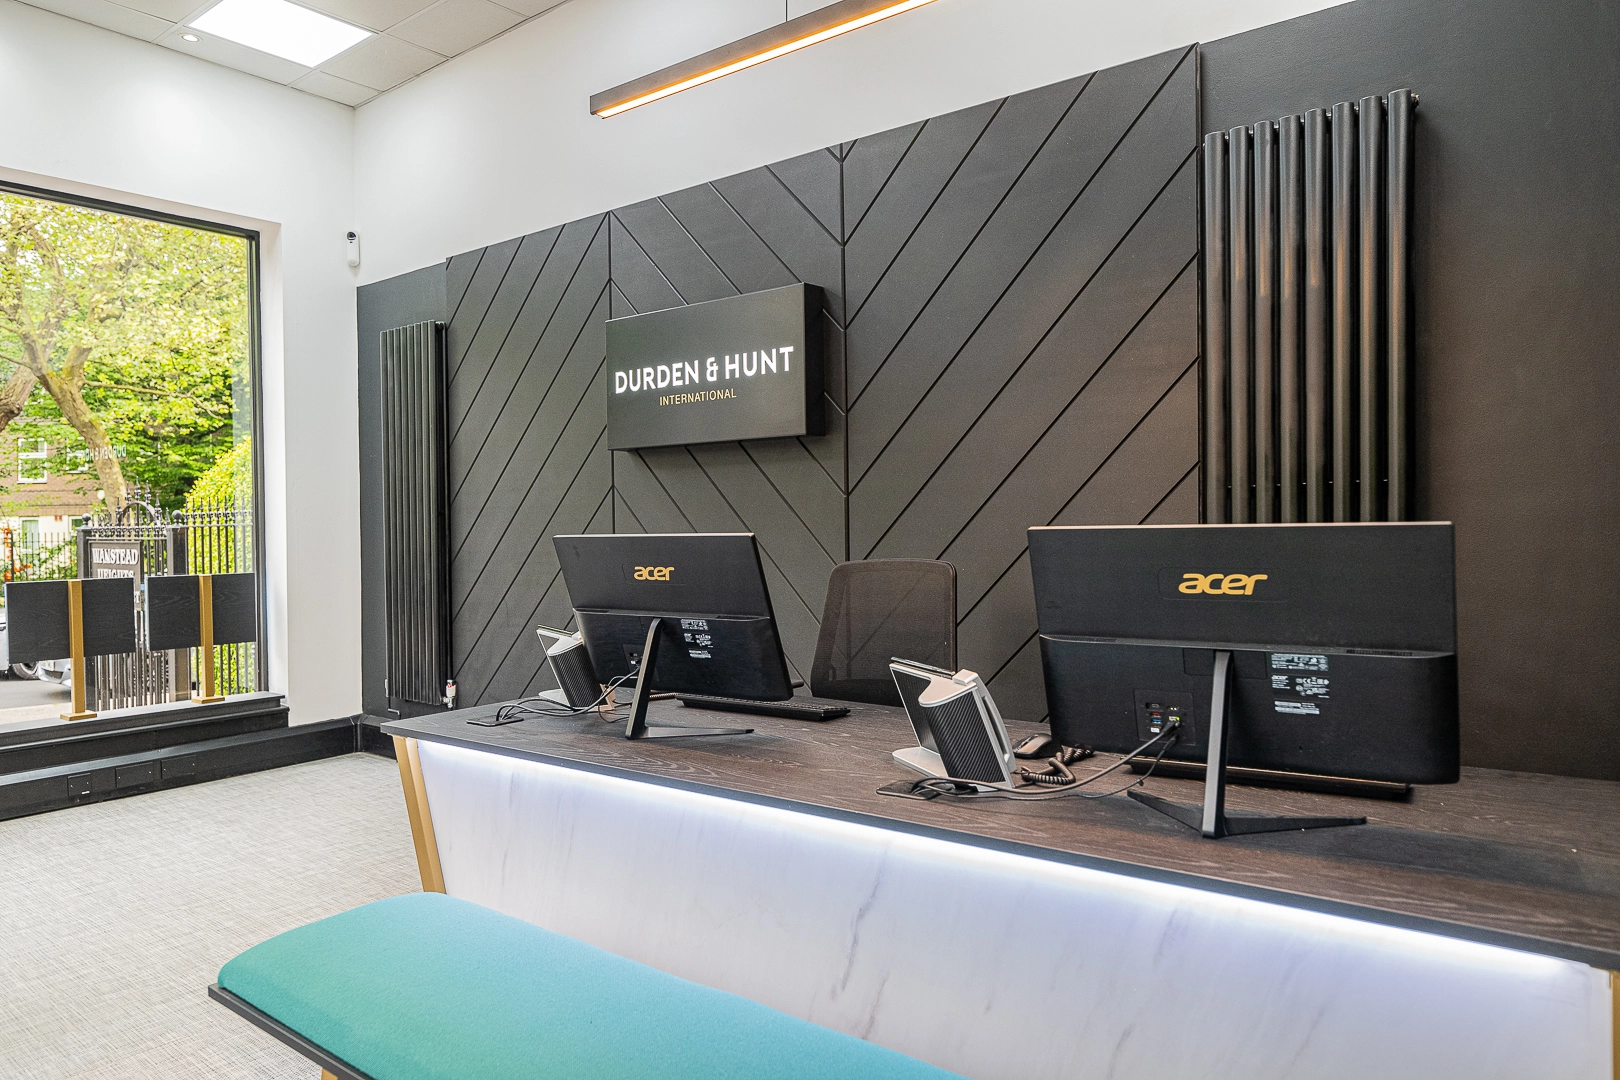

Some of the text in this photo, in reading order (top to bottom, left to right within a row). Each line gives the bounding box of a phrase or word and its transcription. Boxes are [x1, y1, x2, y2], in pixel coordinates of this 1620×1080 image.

[615, 346, 794, 394] DURDEN & HUNT
[659, 388, 737, 406] INTERNATIONAL
[92, 547, 139, 566] WANSTEAD
[634, 566, 674, 581] acer
[1178, 573, 1268, 595] acer
